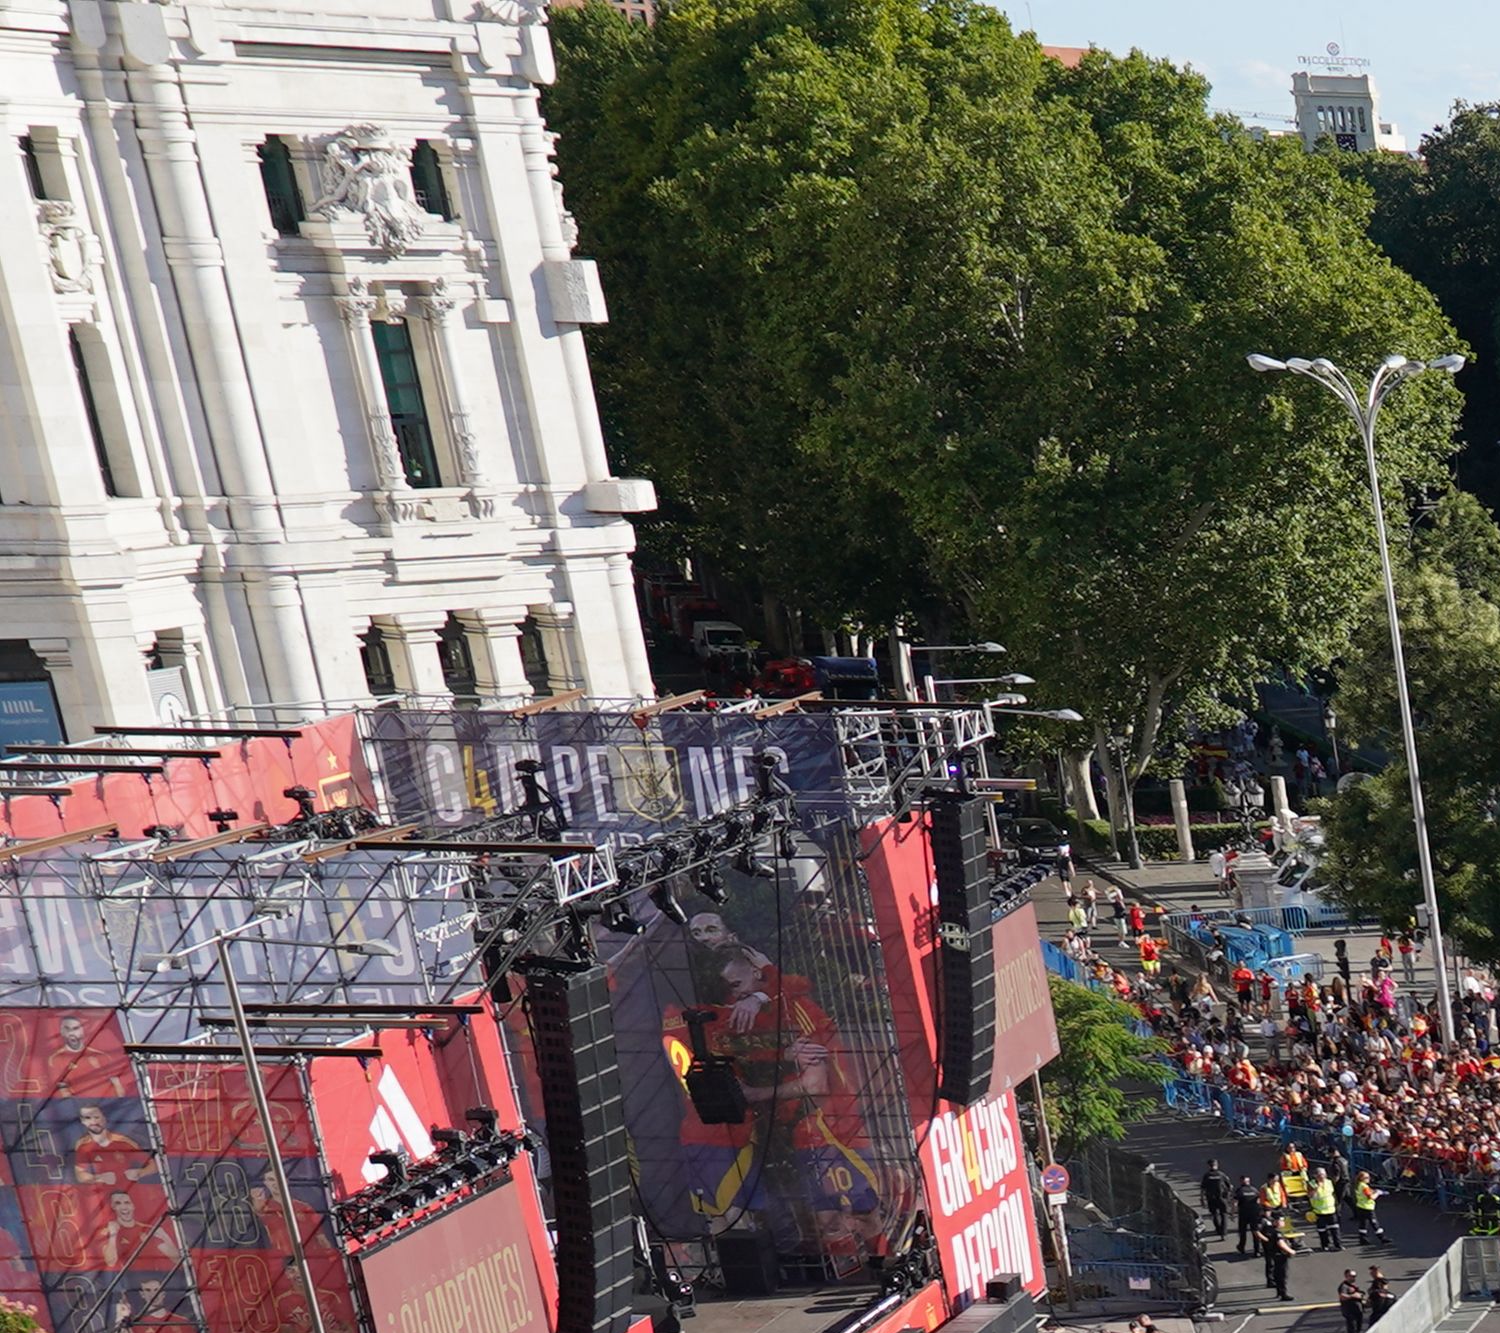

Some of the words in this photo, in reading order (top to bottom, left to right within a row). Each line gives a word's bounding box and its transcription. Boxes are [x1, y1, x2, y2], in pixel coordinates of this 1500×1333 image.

[184, 1161, 260, 1245] 18
[929, 1090, 1018, 1220] GR4CIAS
[950, 1184, 1034, 1296] AFICIÓN
